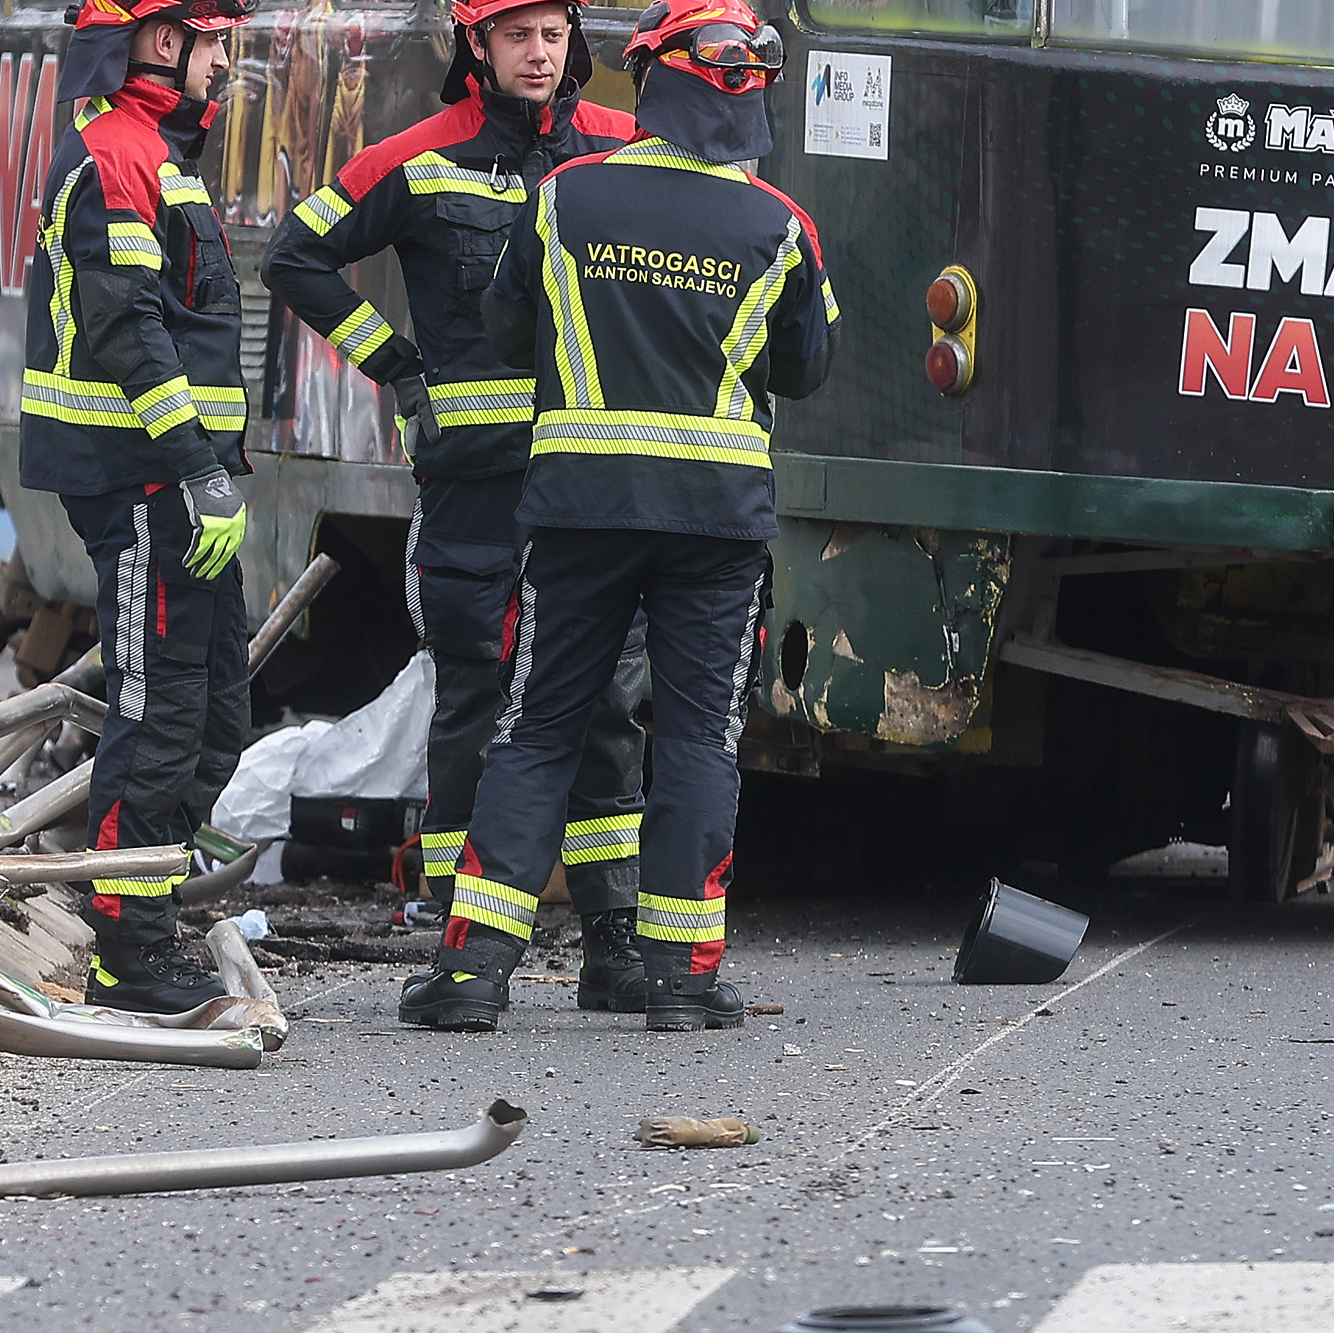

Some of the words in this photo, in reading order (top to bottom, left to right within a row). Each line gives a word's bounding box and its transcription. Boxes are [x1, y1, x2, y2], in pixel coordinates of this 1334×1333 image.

[1200, 163, 1299, 185] PREMIUM
[587, 242, 741, 283] VATROGASCI
[584, 265, 648, 284] KANTON
[651, 271, 736, 299] SARAJEVO
[1178, 308, 1331, 408] NA
